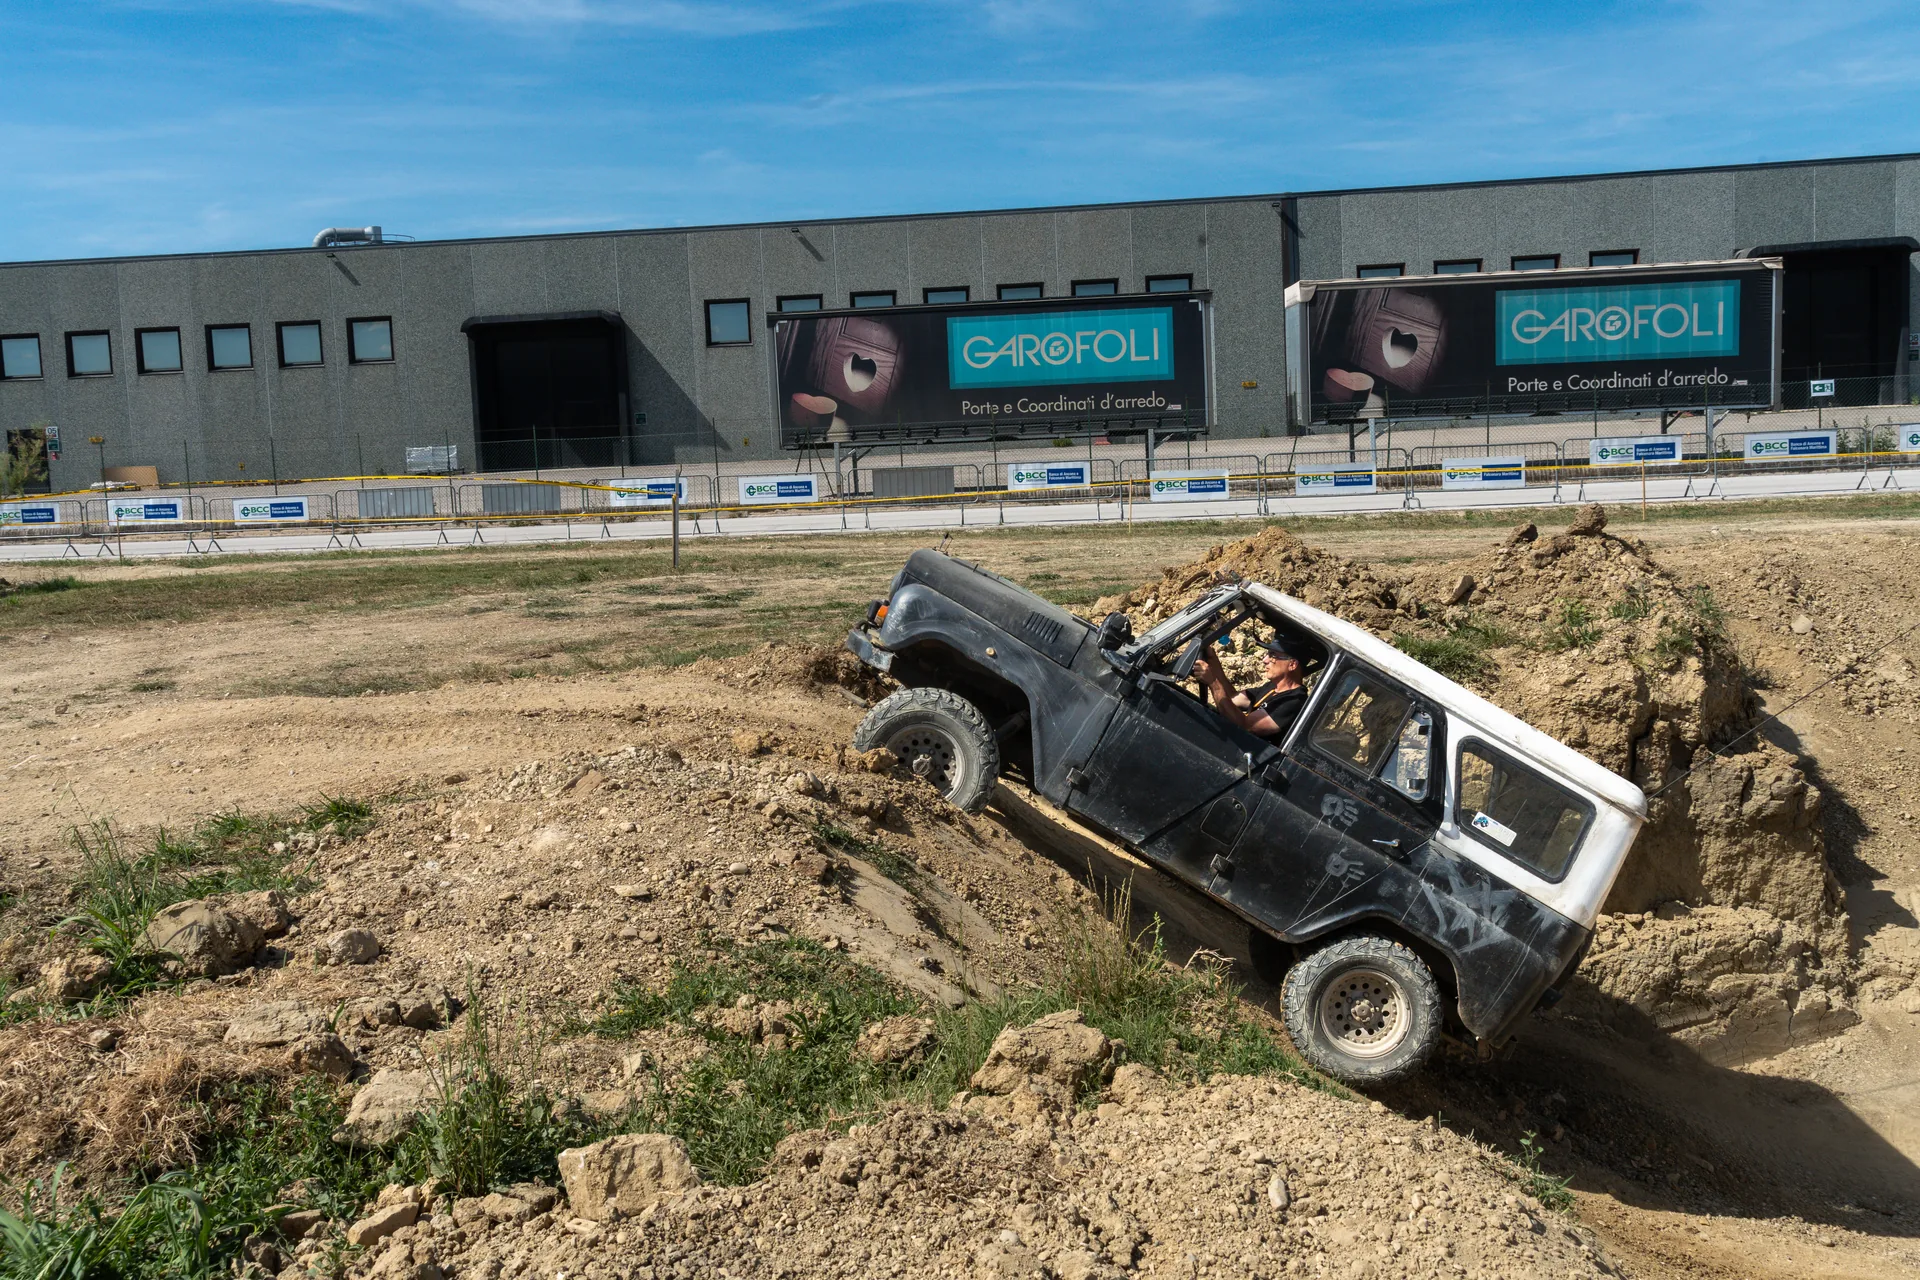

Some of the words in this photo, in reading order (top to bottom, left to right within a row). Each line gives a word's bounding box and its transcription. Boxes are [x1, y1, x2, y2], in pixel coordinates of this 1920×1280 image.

[1512, 301, 1724, 344] GAROFOLI
[962, 327, 1159, 368] GAROFOLI
[1508, 377, 1548, 392] Porte
[1553, 380, 1562, 390] e
[1568, 371, 1651, 390] Coordinati
[1657, 367, 1728, 387] d'arredo
[962, 400, 999, 415] Porte
[1004, 404, 1012, 413] e
[1017, 394, 1095, 413] Coordinati
[1100, 390, 1166, 410] d'arredo
